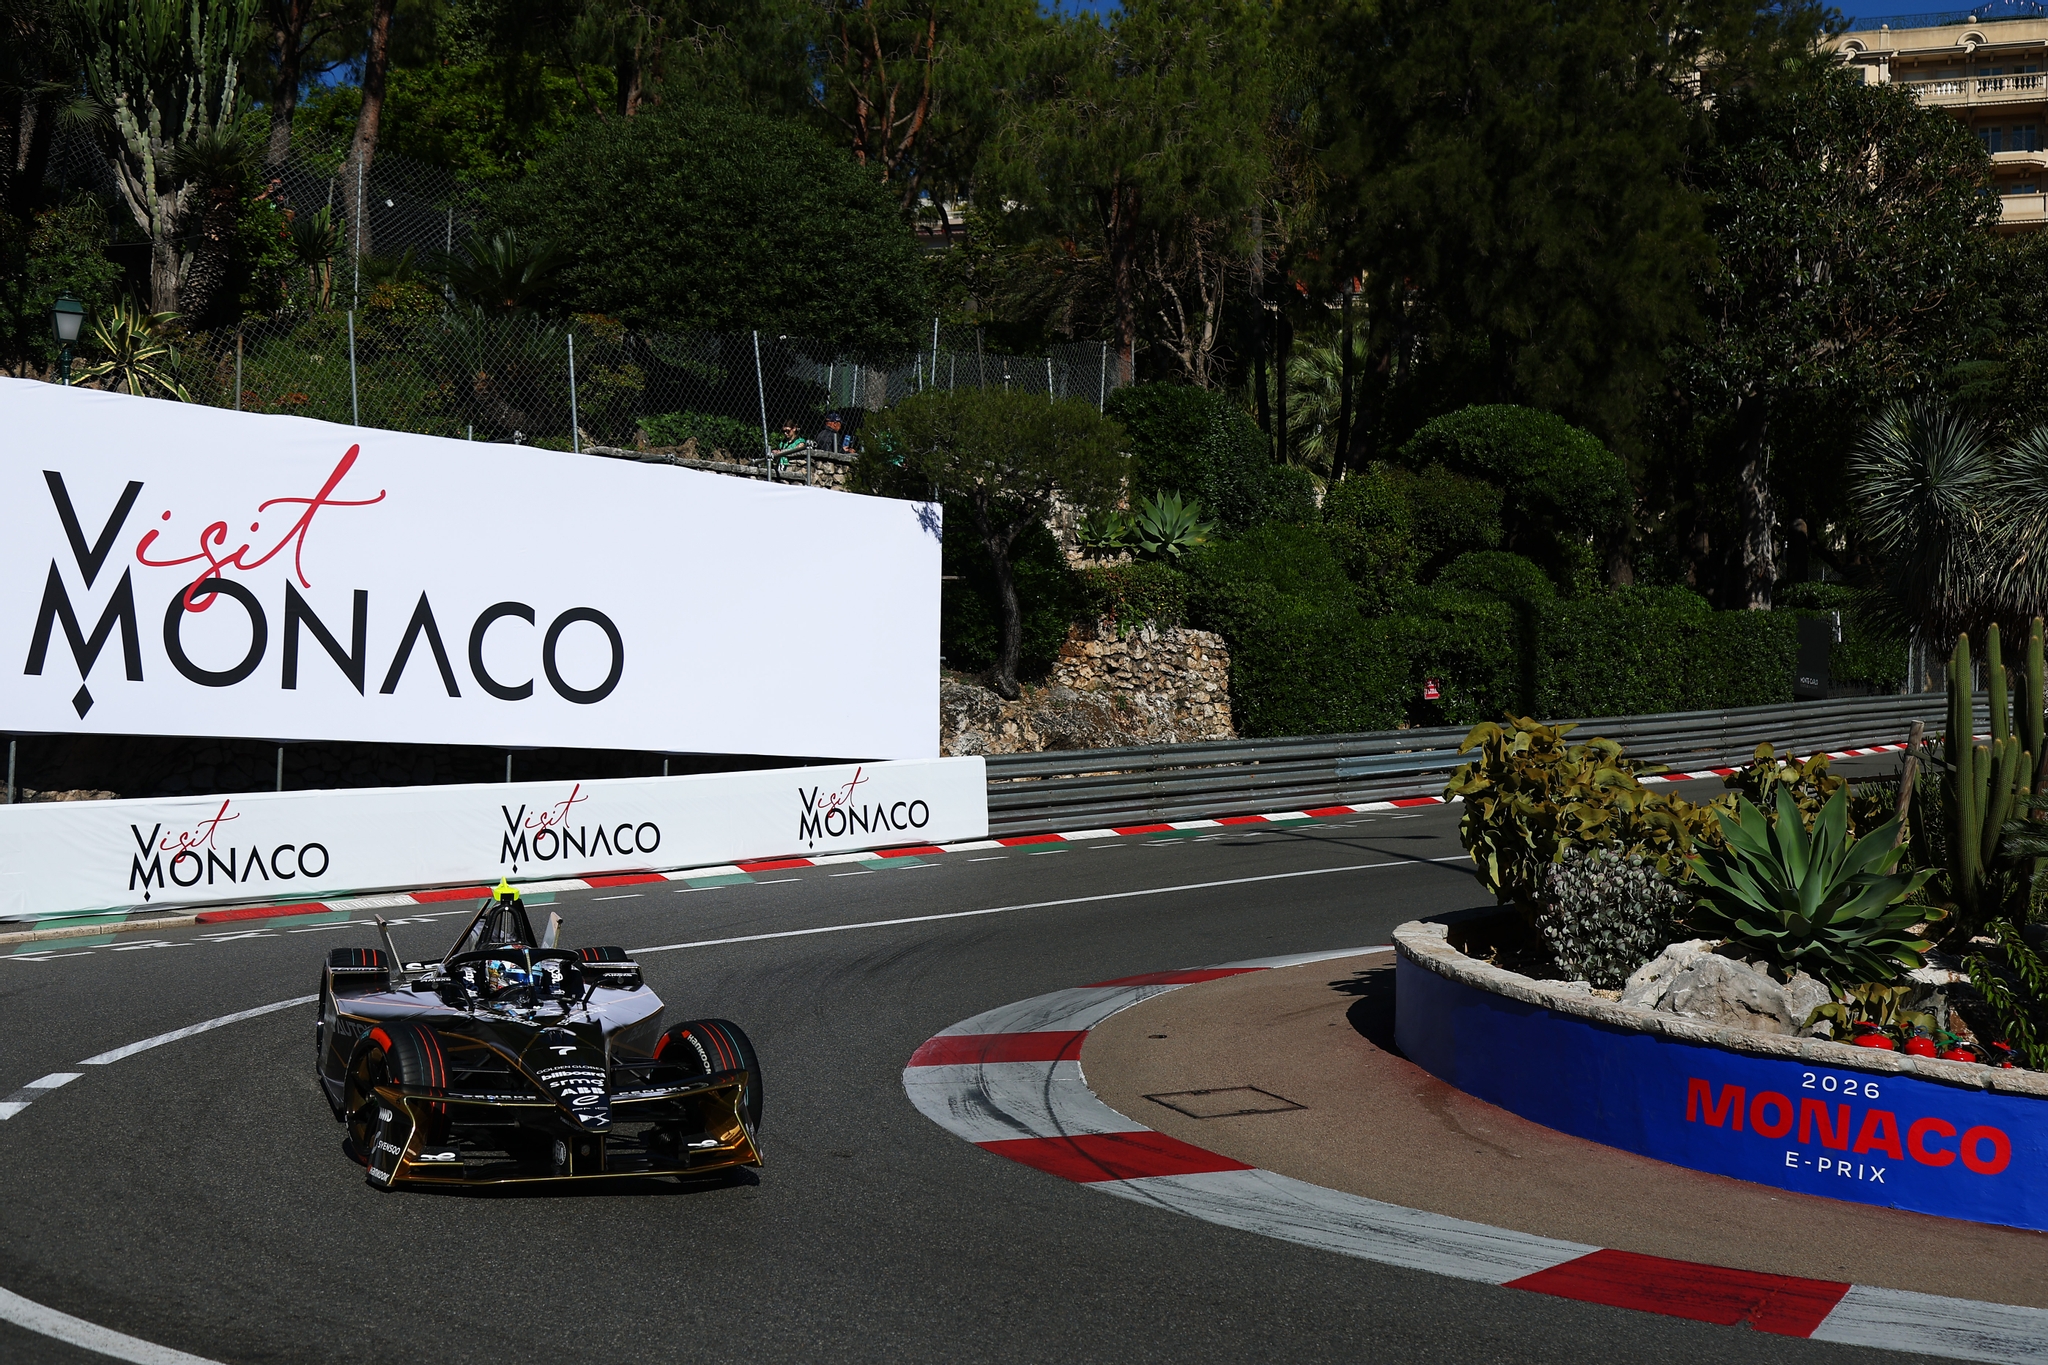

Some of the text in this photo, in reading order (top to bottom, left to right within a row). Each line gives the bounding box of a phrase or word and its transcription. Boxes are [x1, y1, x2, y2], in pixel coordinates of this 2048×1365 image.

[43, 444, 386, 612] Visit
[24, 557, 624, 704] MONACO
[501, 783, 589, 848] Visit
[798, 766, 869, 831] Visit
[798, 797, 930, 842] MONACO
[130, 798, 239, 863] Visit
[500, 821, 661, 864] MONACO
[128, 841, 330, 890] MONACO
[536, 1065, 571, 1075] GOLDEN
[549, 1045, 577, 1056] 7
[541, 1071, 607, 1082] billboard
[560, 1086, 606, 1097] ABB
[1802, 1072, 1880, 1099] 2026
[1685, 1077, 2013, 1175] MONACO
[1785, 1151, 1886, 1184] E-PRIX
